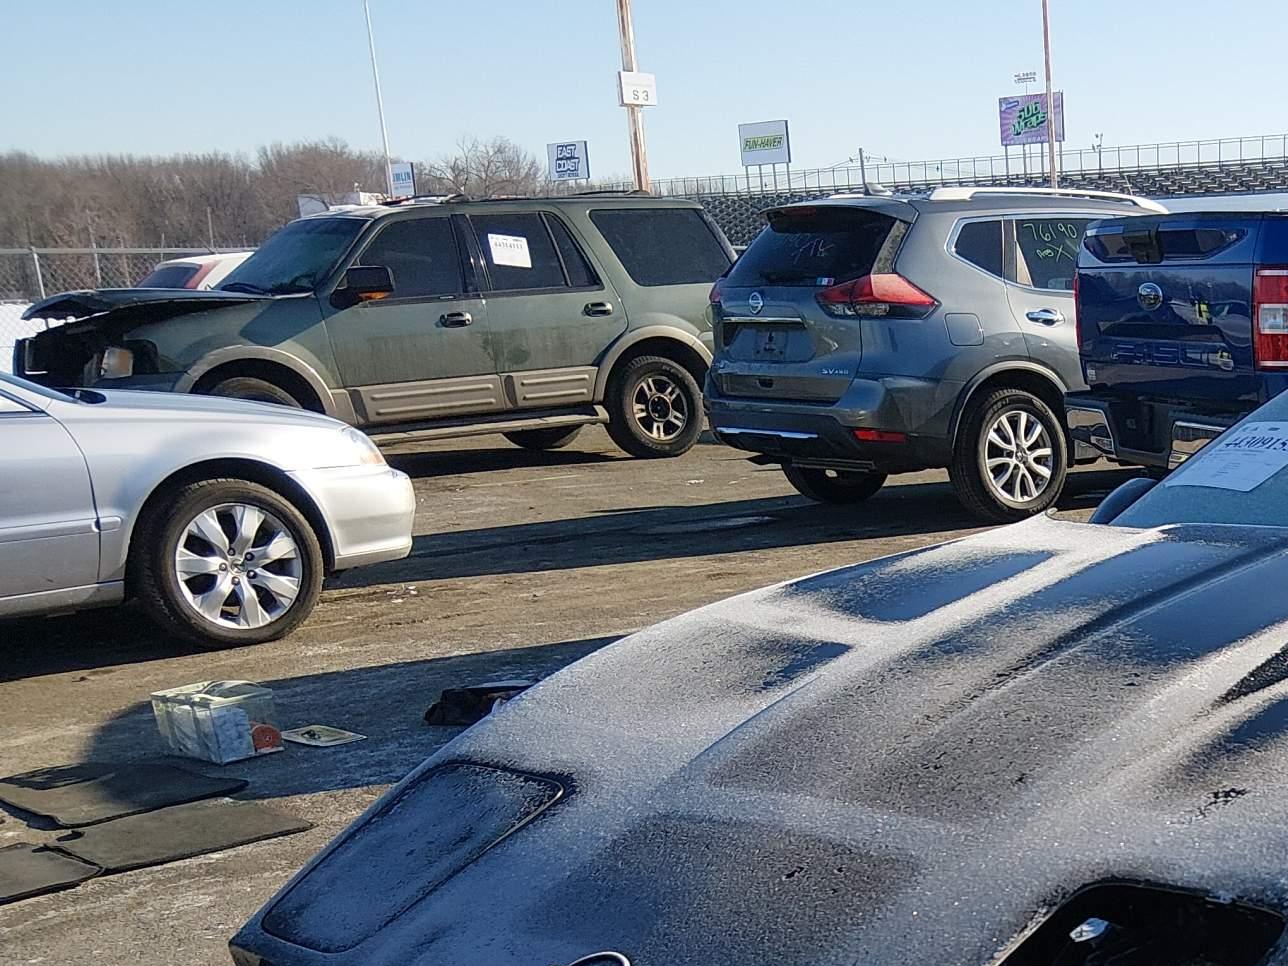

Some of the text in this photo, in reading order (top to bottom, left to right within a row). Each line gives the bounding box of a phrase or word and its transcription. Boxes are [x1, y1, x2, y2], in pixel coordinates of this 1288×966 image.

[632, 87, 649, 102] S 3
[556, 144, 577, 159] EAST
[555, 158, 580, 173] COAST
[1023, 222, 1077, 241] 76190
